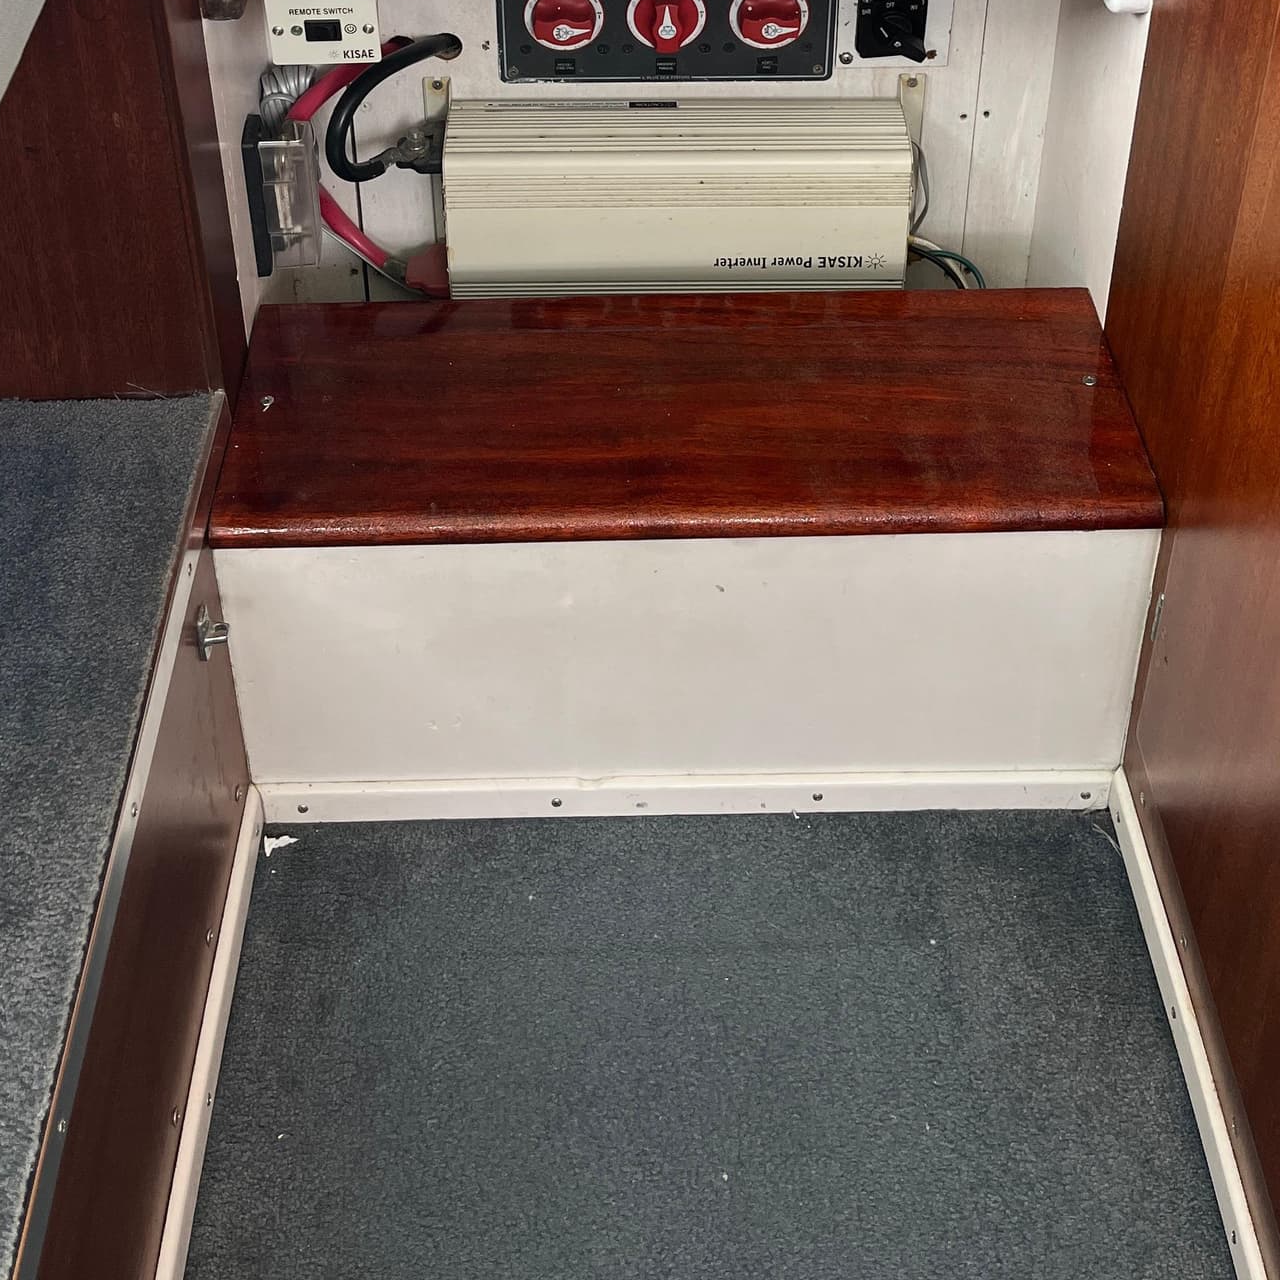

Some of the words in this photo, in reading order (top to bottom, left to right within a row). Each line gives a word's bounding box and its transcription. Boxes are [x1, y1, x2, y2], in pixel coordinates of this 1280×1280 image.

[288, 8, 321, 16] REMOTE
[323, 6, 354, 15] SWITCH
[343, 49, 375, 59] KISAE
[713, 256, 768, 269] Inverter
[771, 256, 813, 269] Power
[818, 256, 863, 269] KISAE
